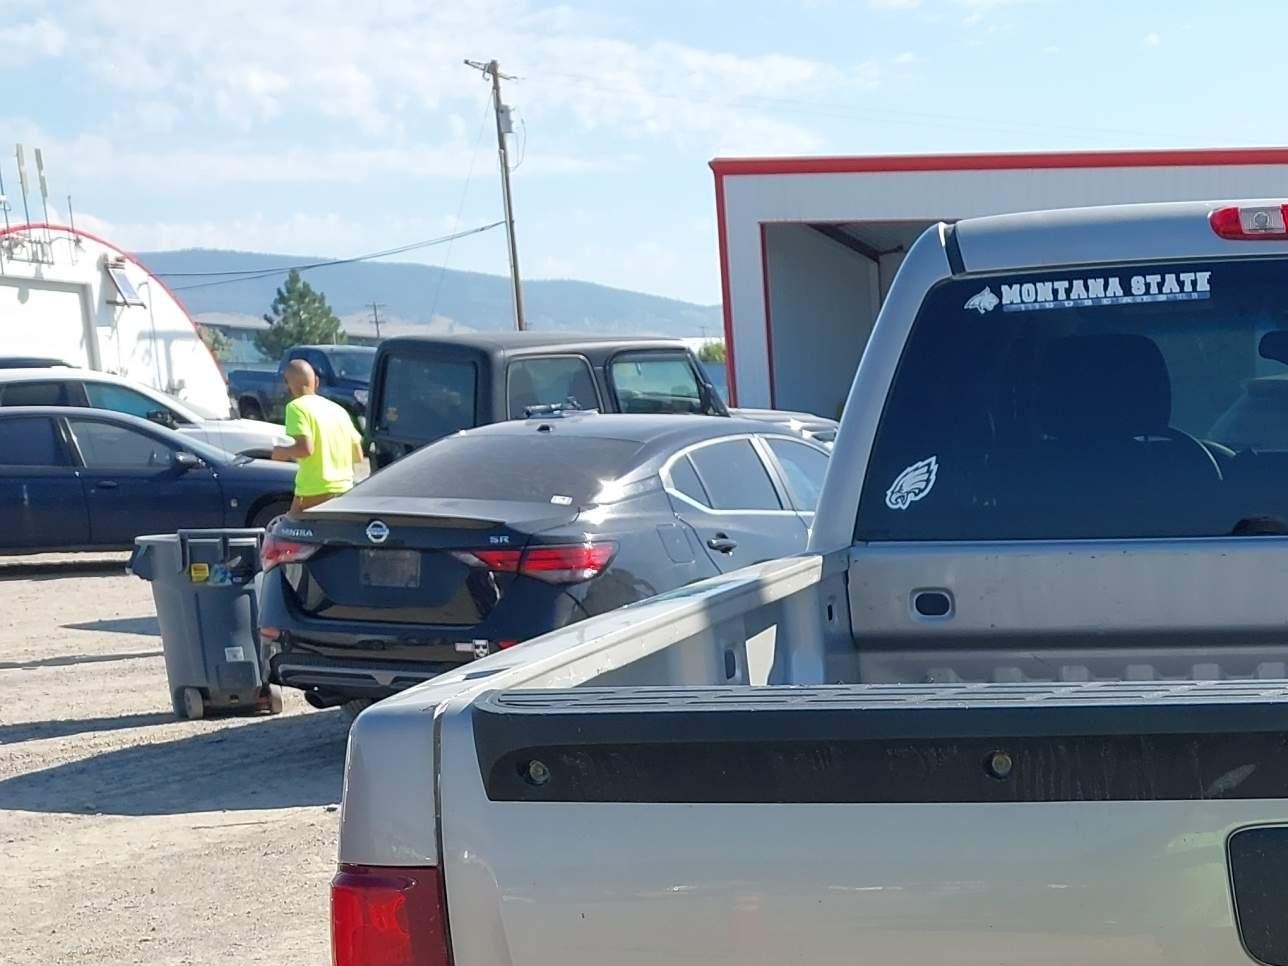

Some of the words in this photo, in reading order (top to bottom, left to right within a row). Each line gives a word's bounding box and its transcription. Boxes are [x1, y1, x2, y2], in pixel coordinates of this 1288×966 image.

[1001, 276, 1123, 304] MONTANA
[1130, 271, 1212, 296] STATE
[489, 535, 510, 544] SR
